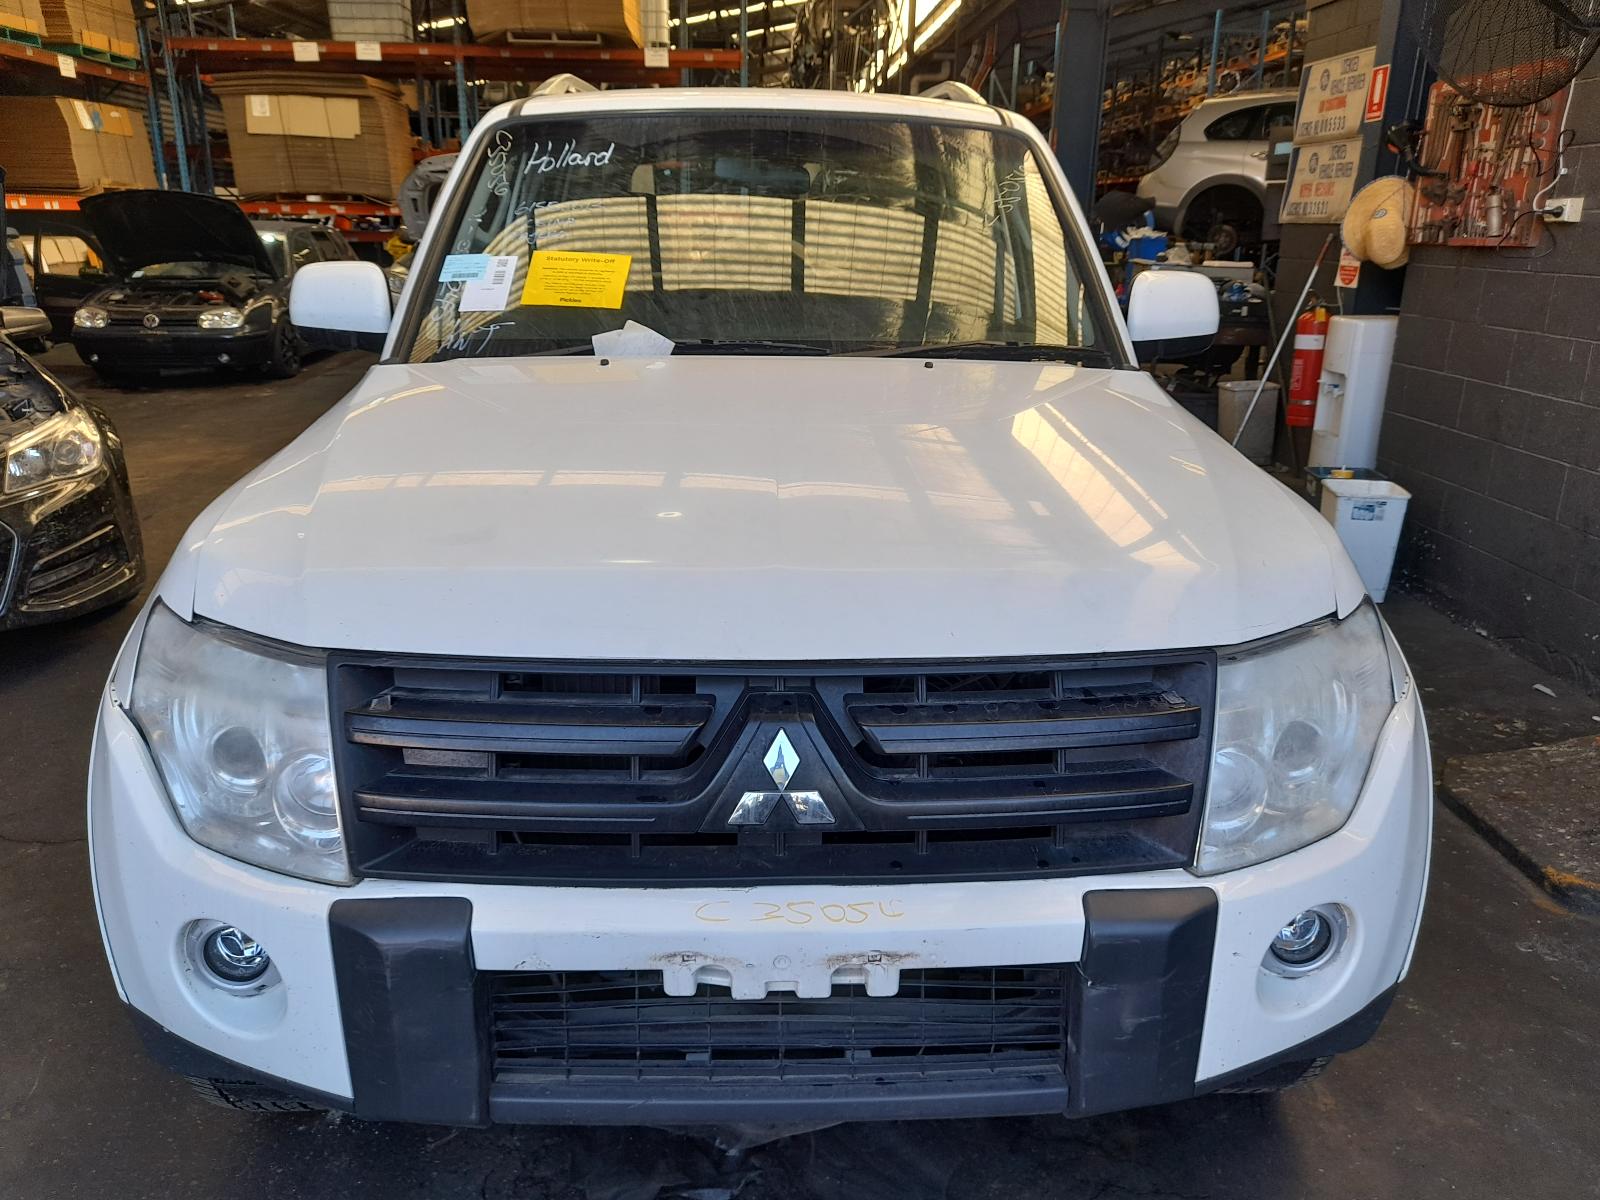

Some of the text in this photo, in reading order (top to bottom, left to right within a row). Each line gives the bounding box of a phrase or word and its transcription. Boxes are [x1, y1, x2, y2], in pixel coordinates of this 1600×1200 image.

[524, 138, 616, 174] Hollard
[545, 255, 616, 264] Statutory Write-Off
